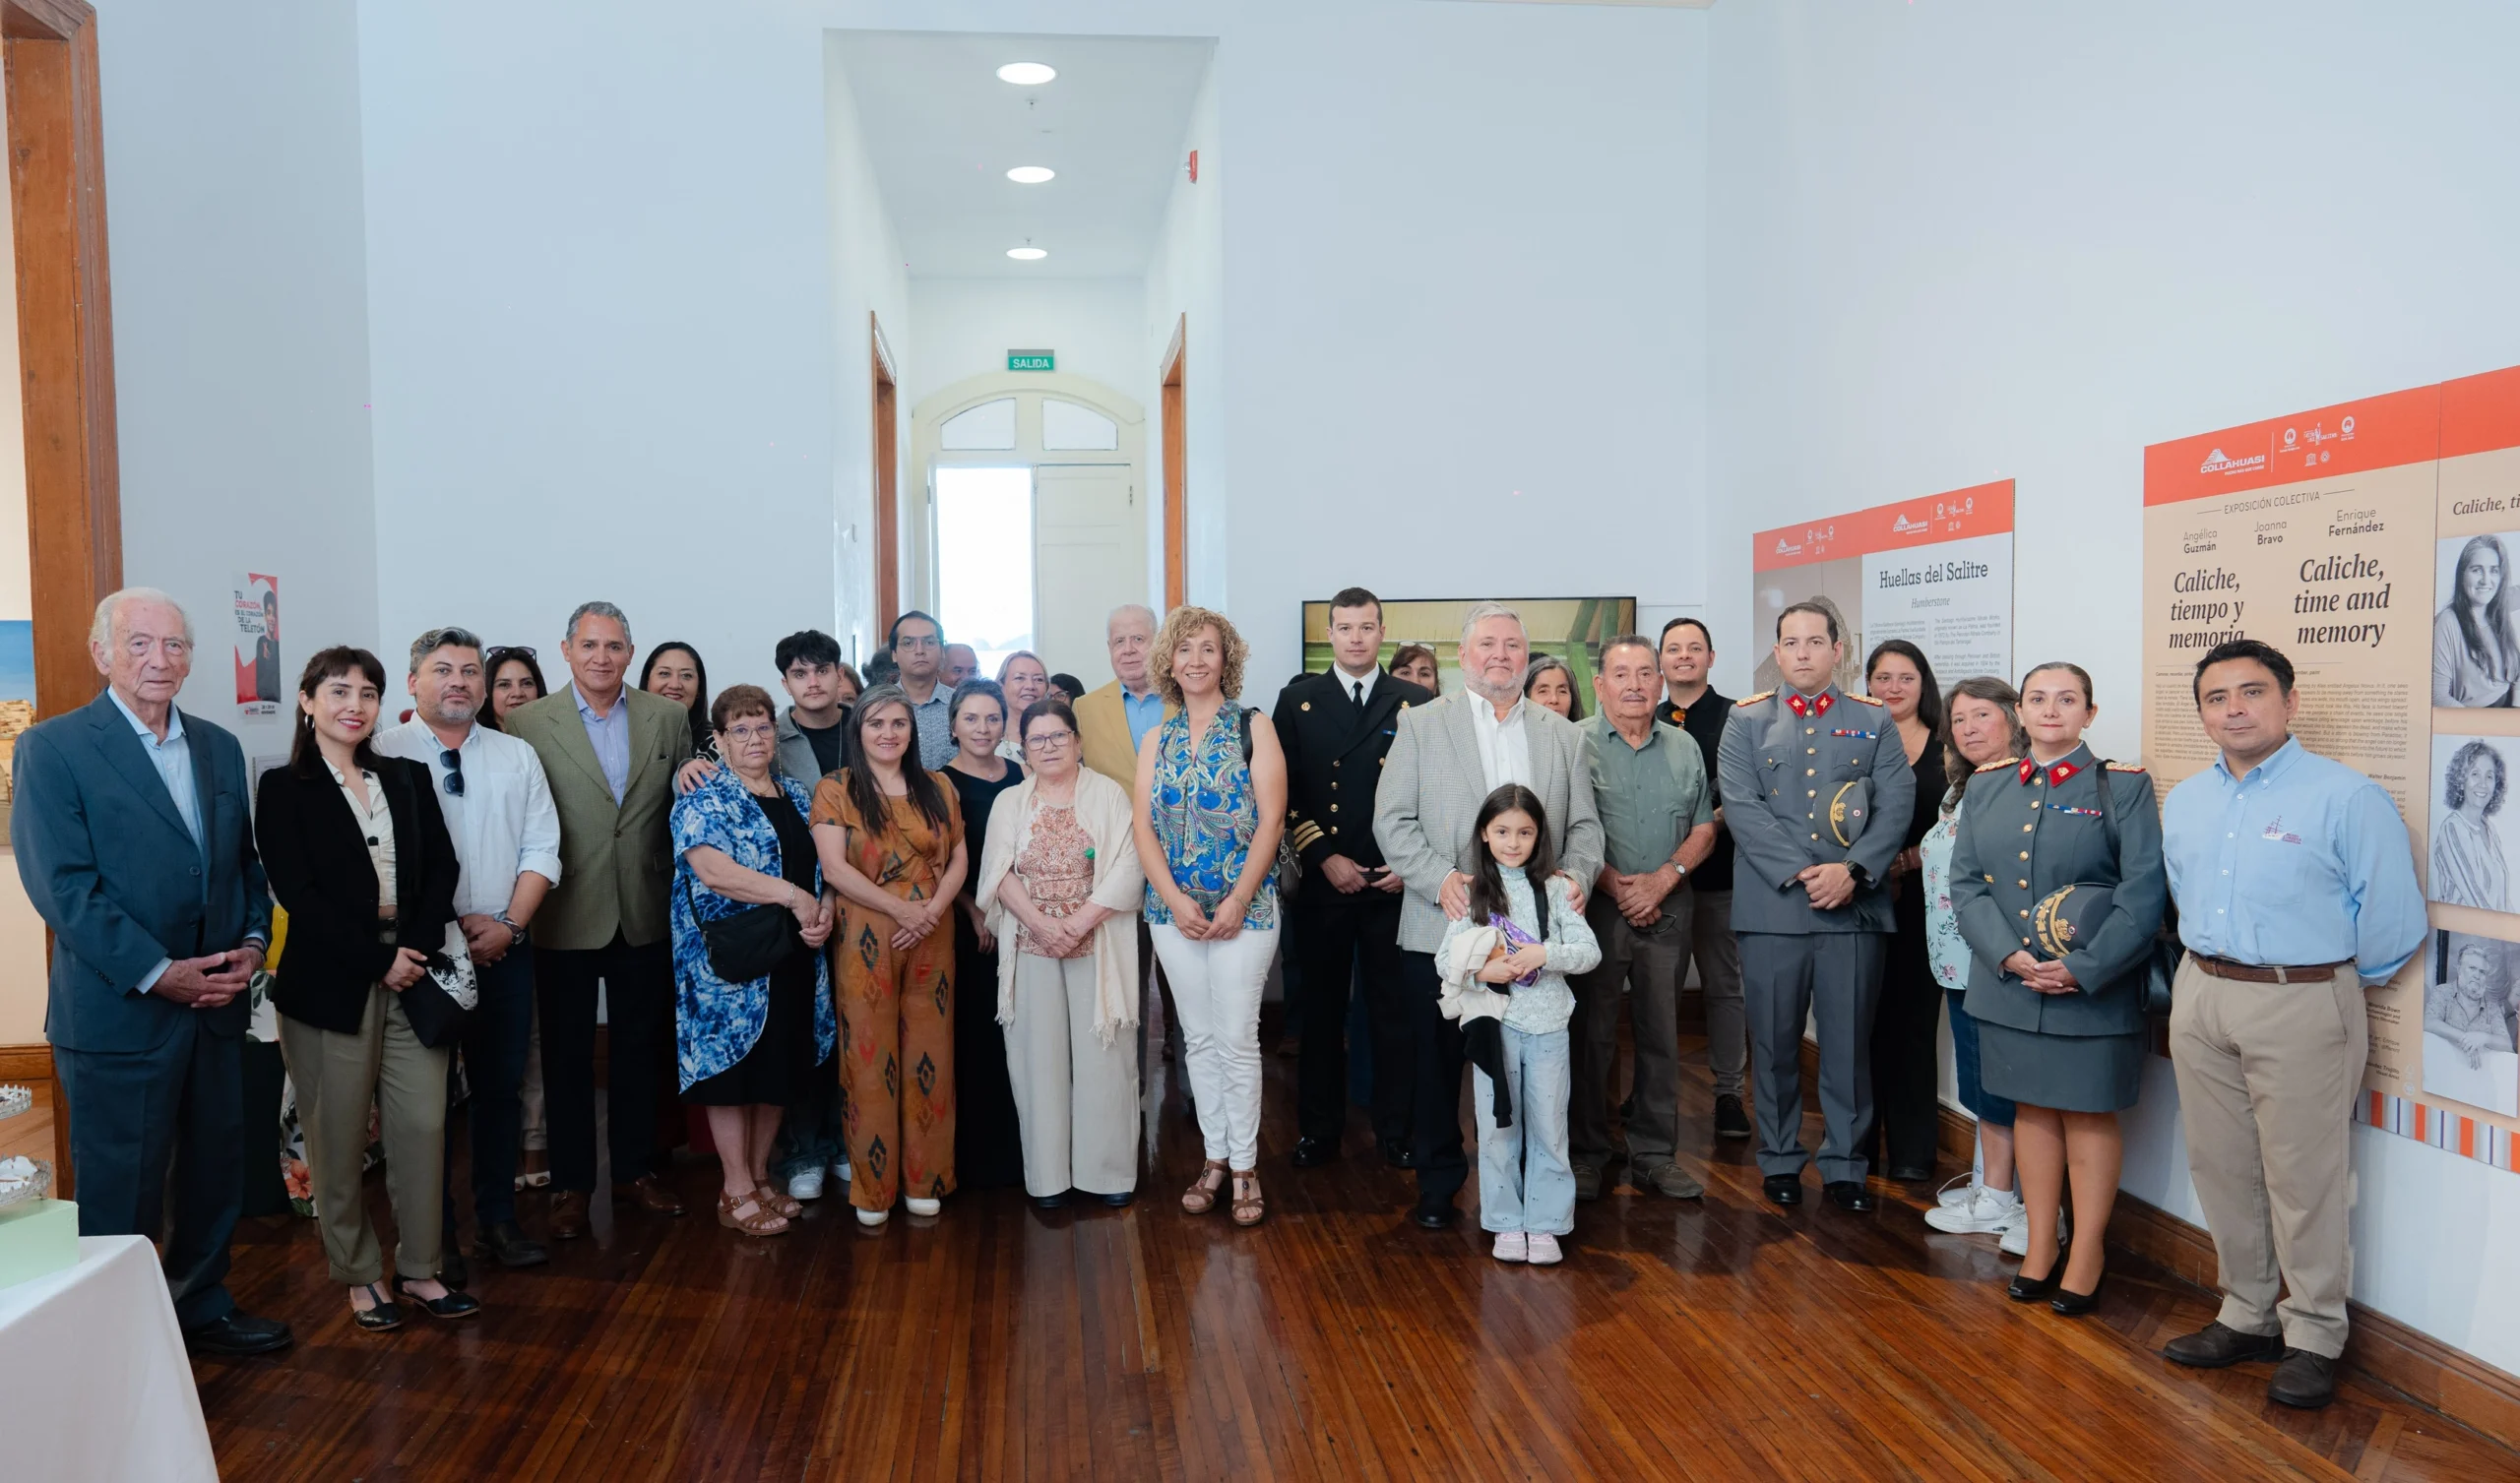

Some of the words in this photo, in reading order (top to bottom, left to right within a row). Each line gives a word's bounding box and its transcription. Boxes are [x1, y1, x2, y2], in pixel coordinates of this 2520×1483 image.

[1013, 358, 1049, 368] SALIDA
[2200, 455, 2265, 473] COLLAHUASI
[2224, 497, 2272, 515] EXPOSICIÓN
[2274, 491, 2320, 507] COLECTIVA
[2452, 496, 2505, 516] Caliche,
[2336, 508, 2377, 524] Enrique
[1893, 521, 1928, 532] COLLAHUASI
[2254, 520, 2288, 533] Joanna
[2328, 520, 2385, 537] Fernández
[2182, 527, 2218, 543] Angélica
[2257, 534, 2284, 546] Bravo
[2183, 540, 2217, 554] Guzmán
[1879, 568, 1922, 588] Huellas
[1924, 563, 1943, 584] del
[1946, 560, 1988, 582] Salitre
[2300, 553, 2384, 583] Caliche,
[2174, 567, 2240, 593] Caliche,
[234, 590, 243, 599] TU
[1911, 596, 1951, 609] Humberstone
[2294, 589, 2340, 614] time
[2346, 583, 2391, 611] and
[2171, 598, 2229, 625] tiempo
[2233, 600, 2244, 624] y
[240, 623, 266, 634] TELETÓN
[2297, 623, 2386, 649] memory
